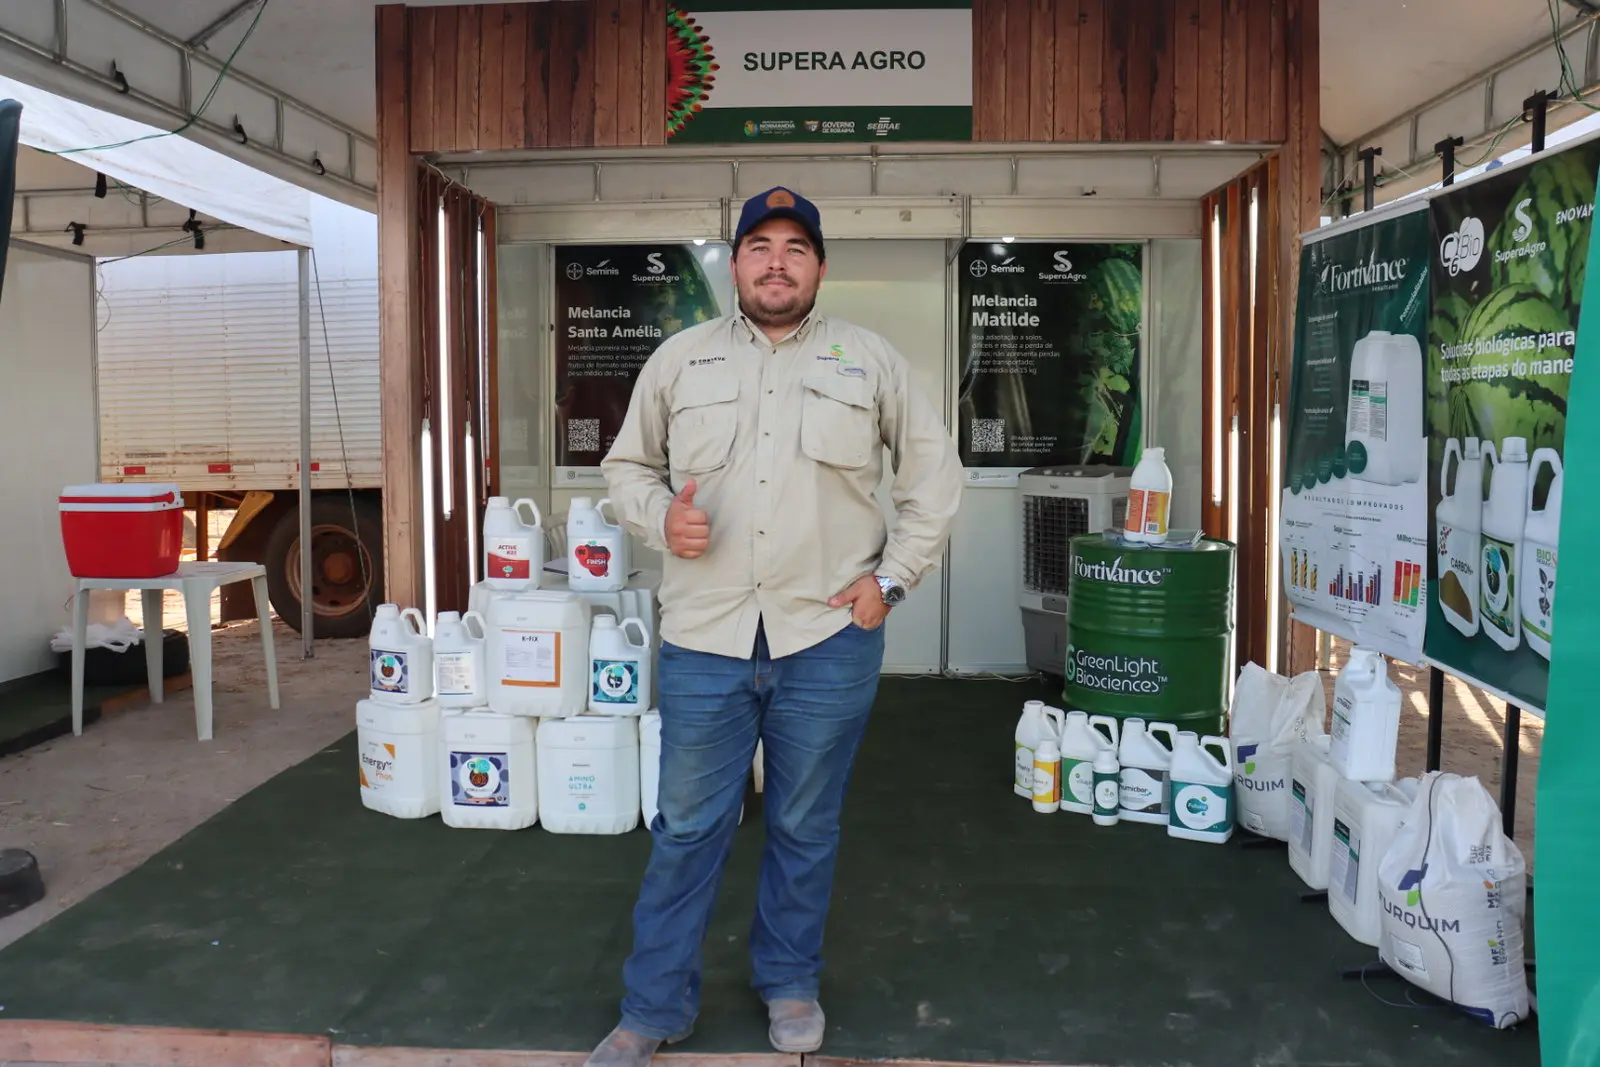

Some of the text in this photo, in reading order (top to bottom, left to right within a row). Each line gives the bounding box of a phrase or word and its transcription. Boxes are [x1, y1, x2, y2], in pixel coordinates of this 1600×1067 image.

[743, 50, 926, 71] SUPERA AGRO
[867, 122, 900, 130] SEBRAE
[1495, 241, 1546, 264] SuperaAgro
[586, 267, 620, 276] Seminis
[991, 264, 1025, 273] Seminis
[1330, 248, 1407, 293] Fortivance
[632, 273, 680, 284] SuperaAgro
[1038, 272, 1087, 282] SuperaAgro
[971, 294, 1038, 307] Melancia
[567, 306, 631, 319] Melancia
[971, 311, 1040, 327] Matilde
[567, 324, 662, 338] Santa Amélia
[1474, 332, 1536, 357] biológicas
[1537, 330, 1576, 353] para
[1440, 365, 1460, 382] todas
[1461, 367, 1470, 380] as
[1471, 362, 1509, 382] etapas
[1511, 358, 1527, 377] do
[1076, 649, 1159, 678] GreenLight
[1378, 890, 1461, 933] FURQUIM
